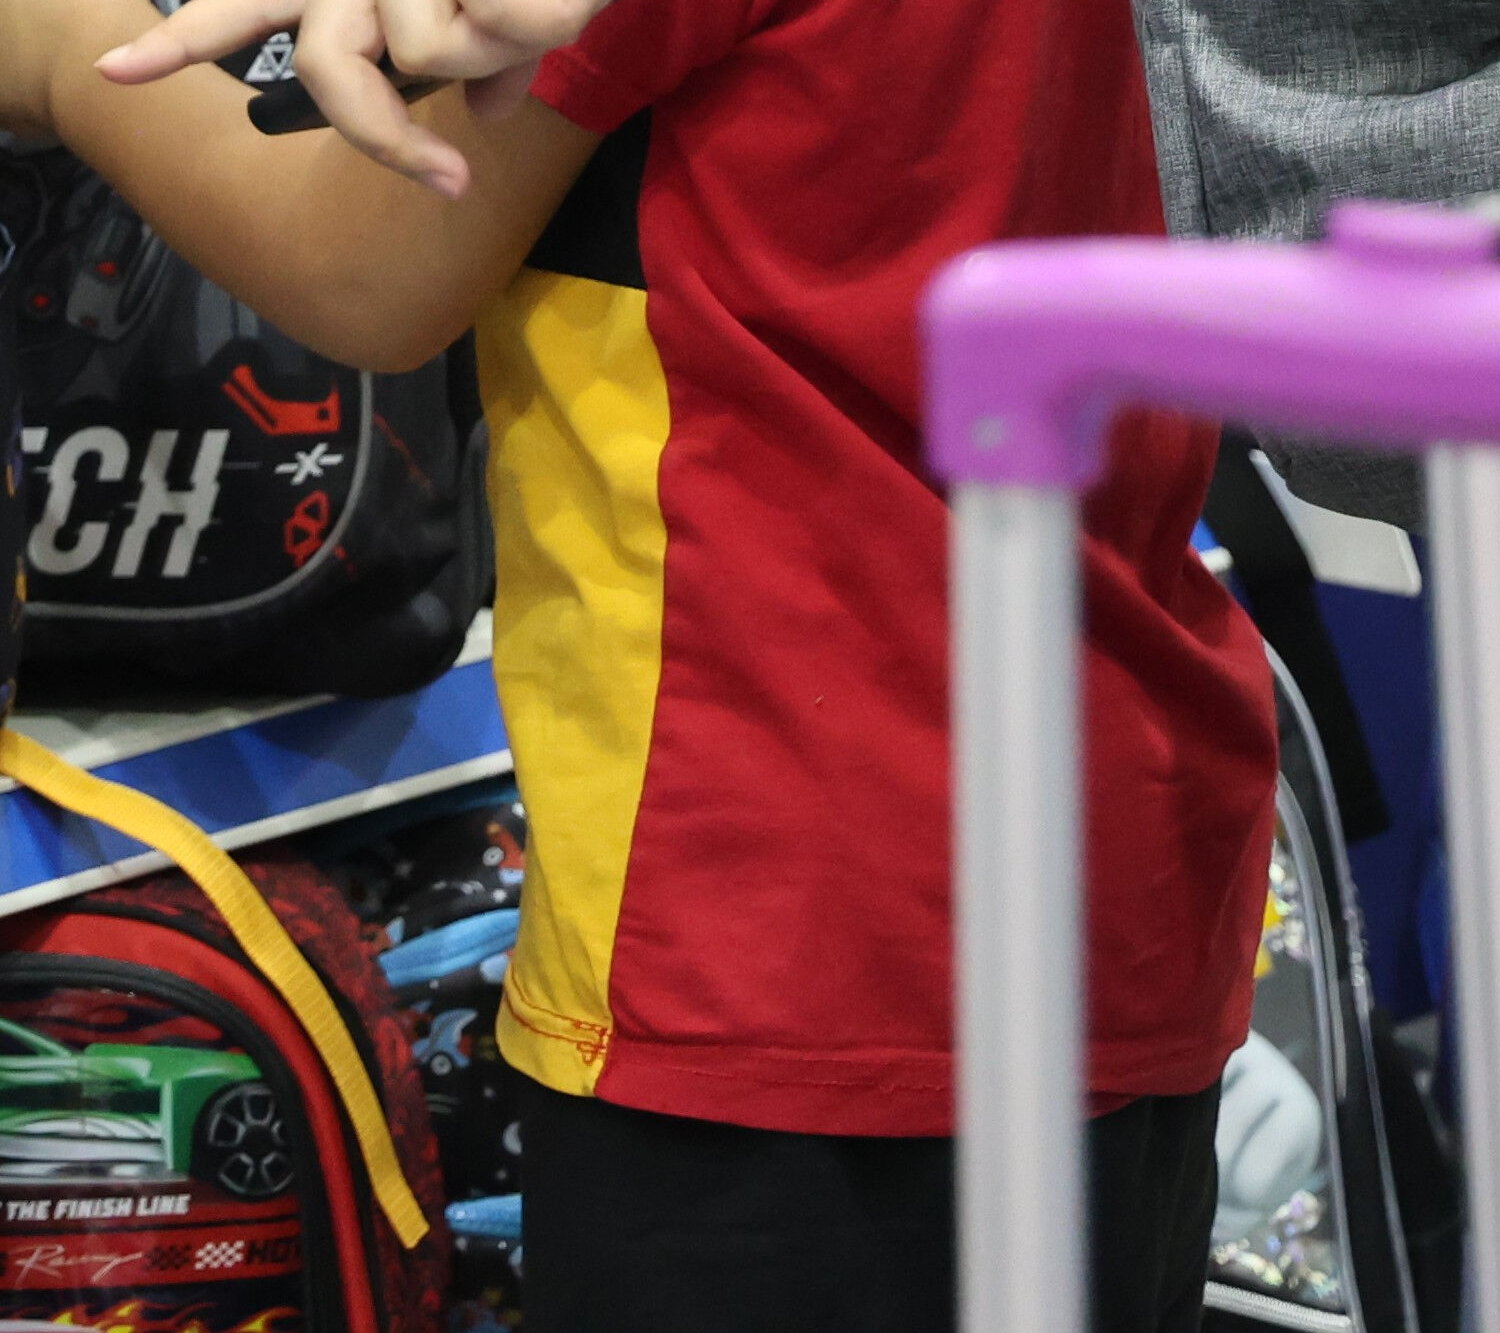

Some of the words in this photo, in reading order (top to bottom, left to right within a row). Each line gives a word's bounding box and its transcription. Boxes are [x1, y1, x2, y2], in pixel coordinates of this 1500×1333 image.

[20, 425, 230, 578] CH
[6, 1199, 52, 1222] THE
[54, 1196, 131, 1220] FINISH
[136, 1194, 191, 1216] LINE
